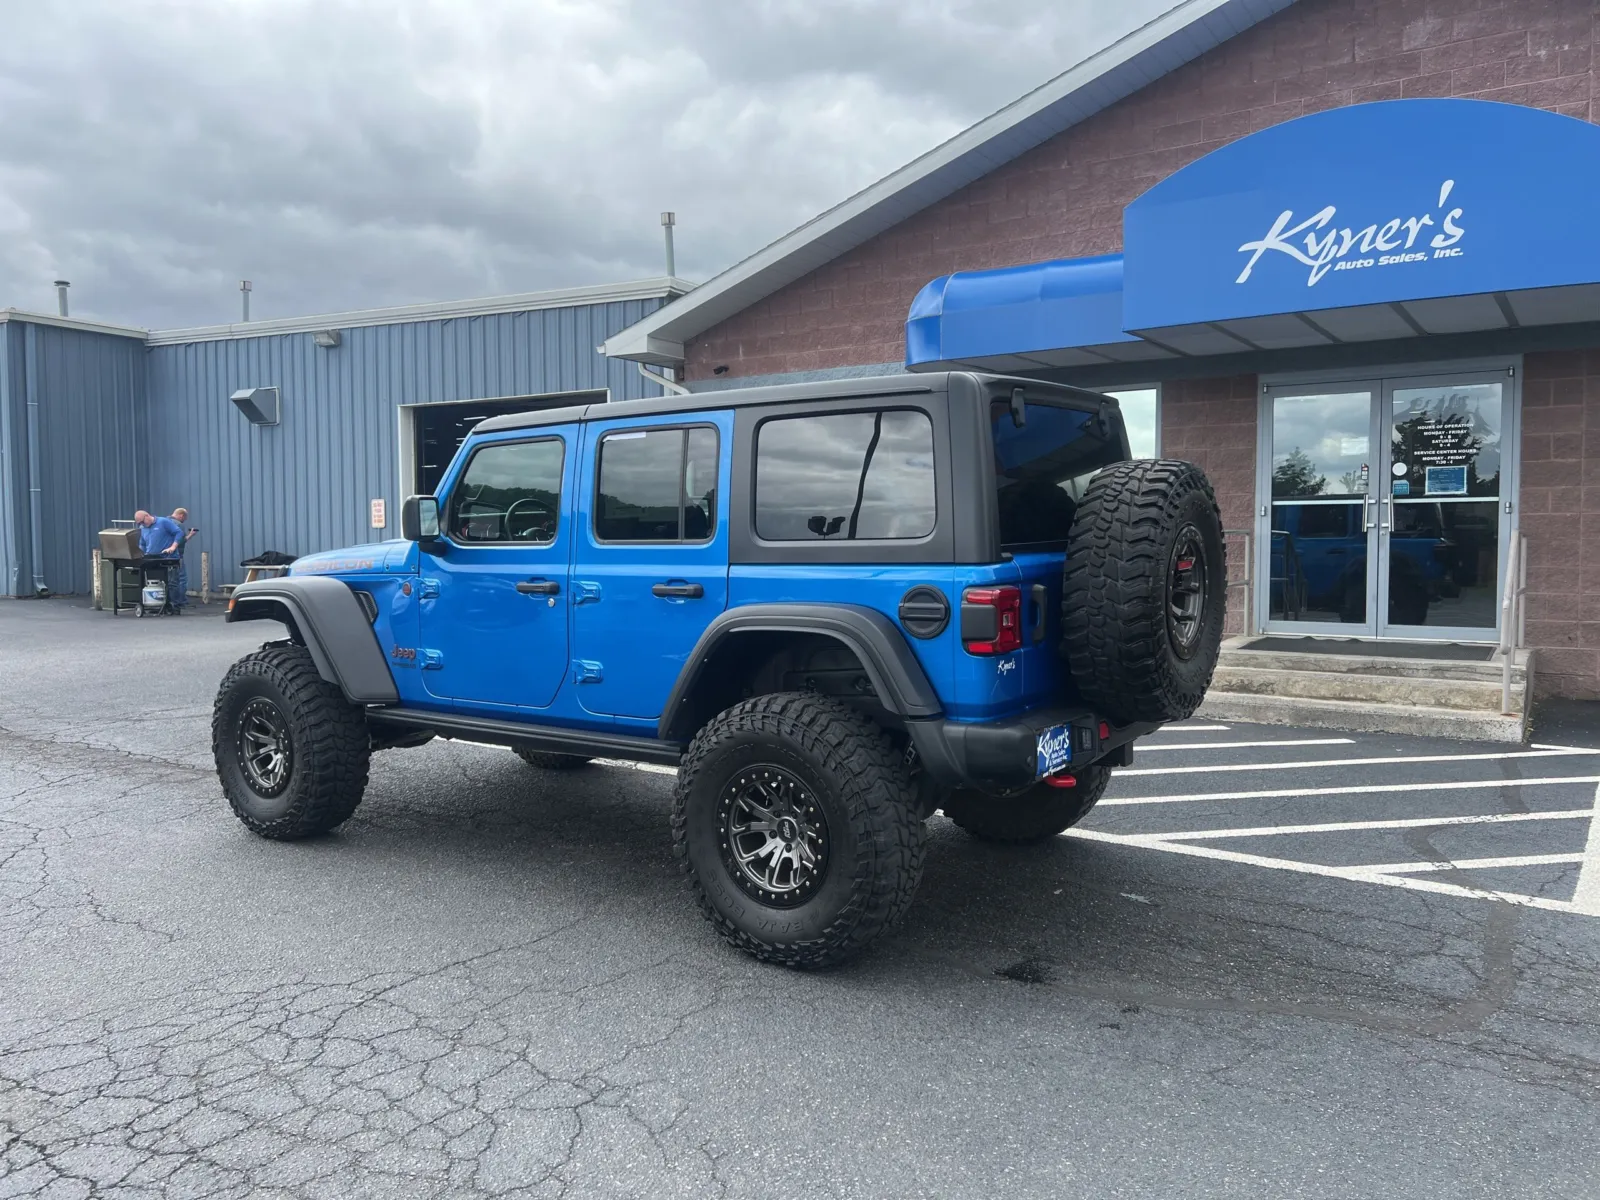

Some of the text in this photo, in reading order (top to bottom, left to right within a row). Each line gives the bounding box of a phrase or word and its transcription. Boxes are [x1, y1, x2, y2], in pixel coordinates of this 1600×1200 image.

[1235, 179, 1465, 287] Kyner's
[1334, 247, 1464, 271] Auto Sales, Inc.
[390, 644, 416, 662] Jeep
[997, 658, 1016, 676] Kyner's
[1037, 728, 1070, 768] Kyner's
